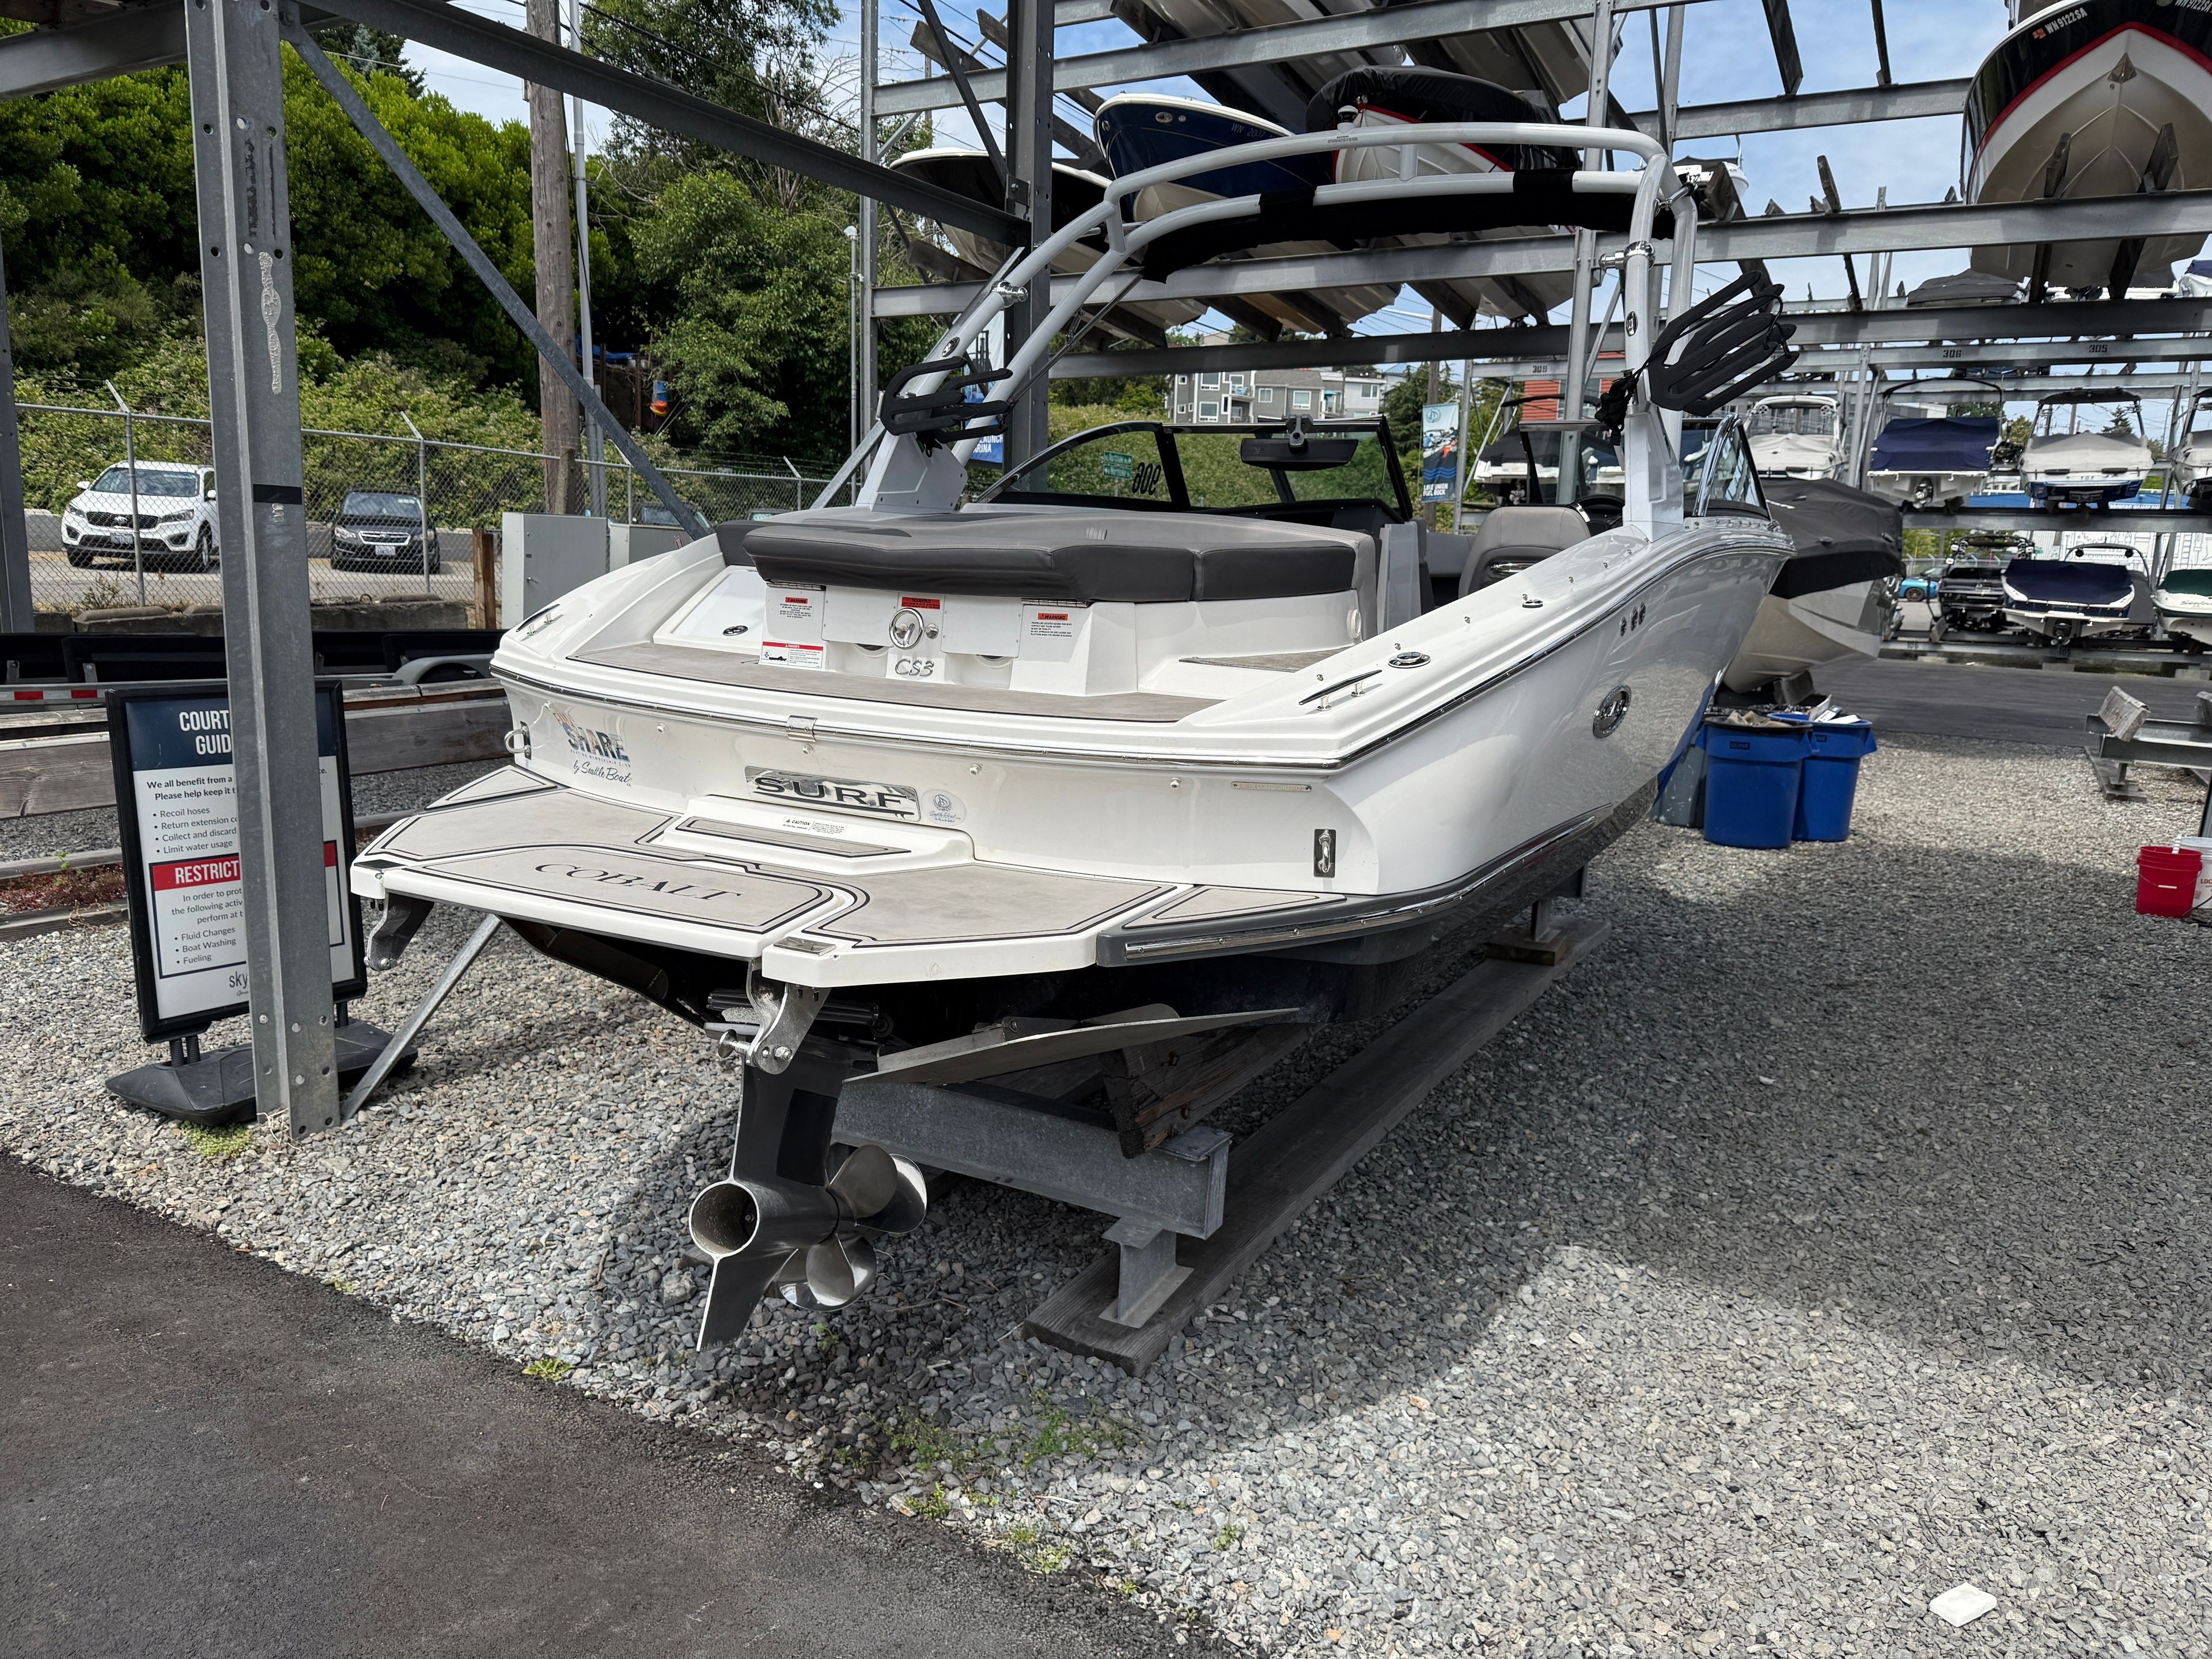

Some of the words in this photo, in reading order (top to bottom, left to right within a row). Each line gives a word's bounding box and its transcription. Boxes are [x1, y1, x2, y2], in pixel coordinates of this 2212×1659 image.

[1943, 350, 1961, 358] 306
[2089, 344, 2108, 353] 305
[895, 658, 934, 677] CS3
[179, 710, 229, 732] COURT
[195, 734, 232, 755] GUID
[562, 722, 630, 762] SHARE
[570, 749, 587, 757] BOATING
[589, 755, 616, 764] MEMBERSHIP
[573, 760, 579, 774] by
[581, 762, 605, 778] Seattle
[606, 767, 632, 783] Boat
[164, 779, 174, 787] all
[176, 778, 206, 787] benefit
[155, 792, 182, 800] Please
[184, 791, 202, 800] help
[204, 788, 223, 797] keep
[755, 777, 907, 808] SURF
[160, 809, 185, 817] Recoil
[187, 807, 210, 816] hoses
[161, 819, 189, 830] Return
[191, 817, 229, 827] extension
[162, 831, 191, 842] Collect
[193, 830, 207, 839] and
[210, 827, 236, 837] discard
[164, 844, 184, 854] Limit
[186, 843, 209, 851] water
[211, 841, 233, 850] usage
[175, 860, 239, 884] RESTRICT
[535, 863, 743, 900] COBALT
[193, 892, 214, 901] order
[187, 902, 224, 913] following
[198, 913, 228, 925] perform
[181, 931, 200, 941] Fluid
[203, 927, 236, 938] Changes
[183, 943, 201, 953] Boat
[203, 937, 236, 949] Washing
[183, 953, 212, 964] Fueling
